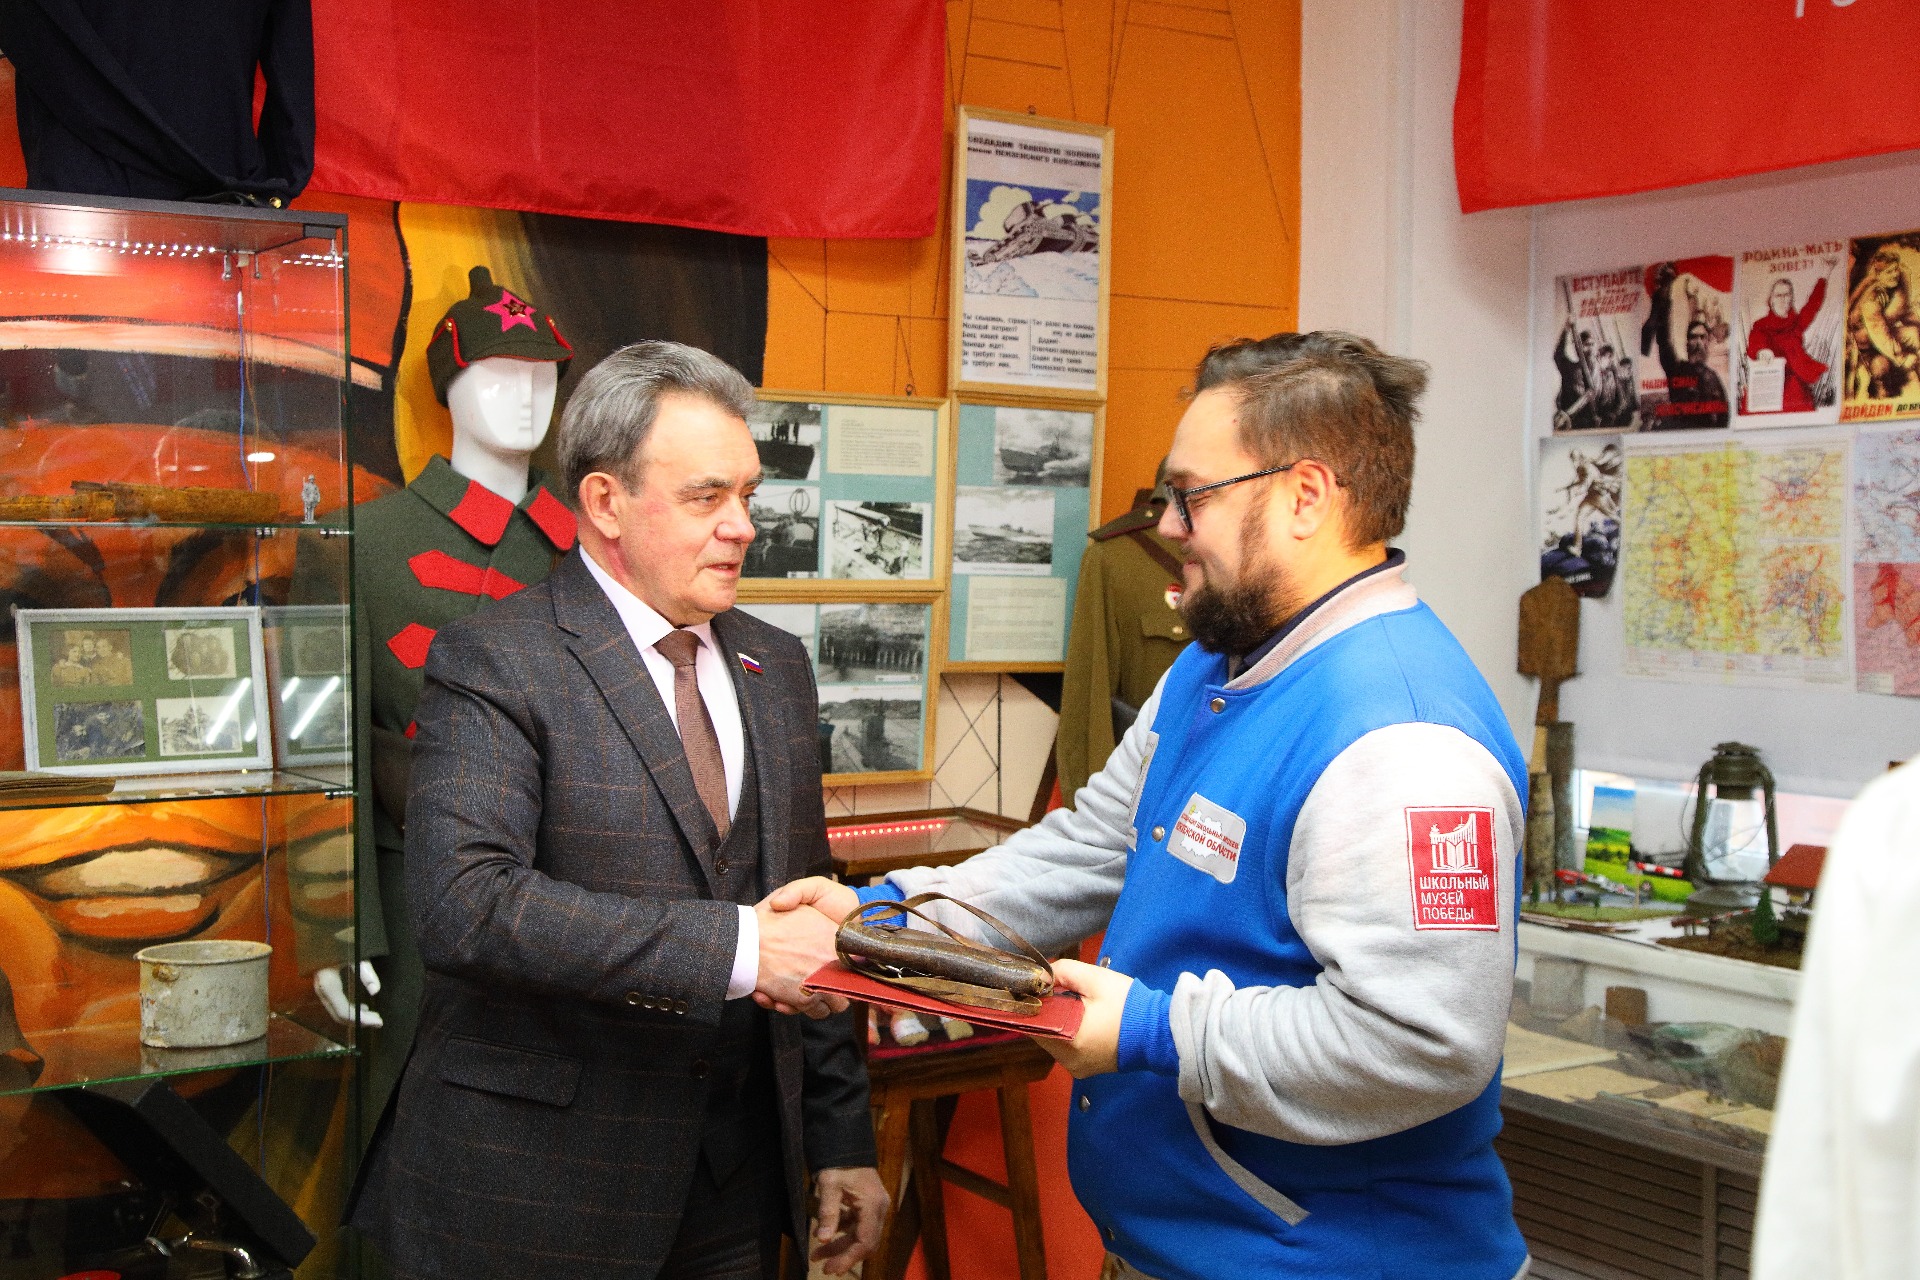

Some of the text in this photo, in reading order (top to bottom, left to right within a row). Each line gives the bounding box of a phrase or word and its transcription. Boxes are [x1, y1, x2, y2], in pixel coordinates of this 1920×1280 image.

[1206, 839, 1237, 862] ОБЛАСТИ
[1420, 874, 1489, 890] ШКОЛЬНЫЙ
[1421, 890, 1464, 905] МУЗЕЙ
[1422, 907, 1474, 922] ПОБЕДЫ
